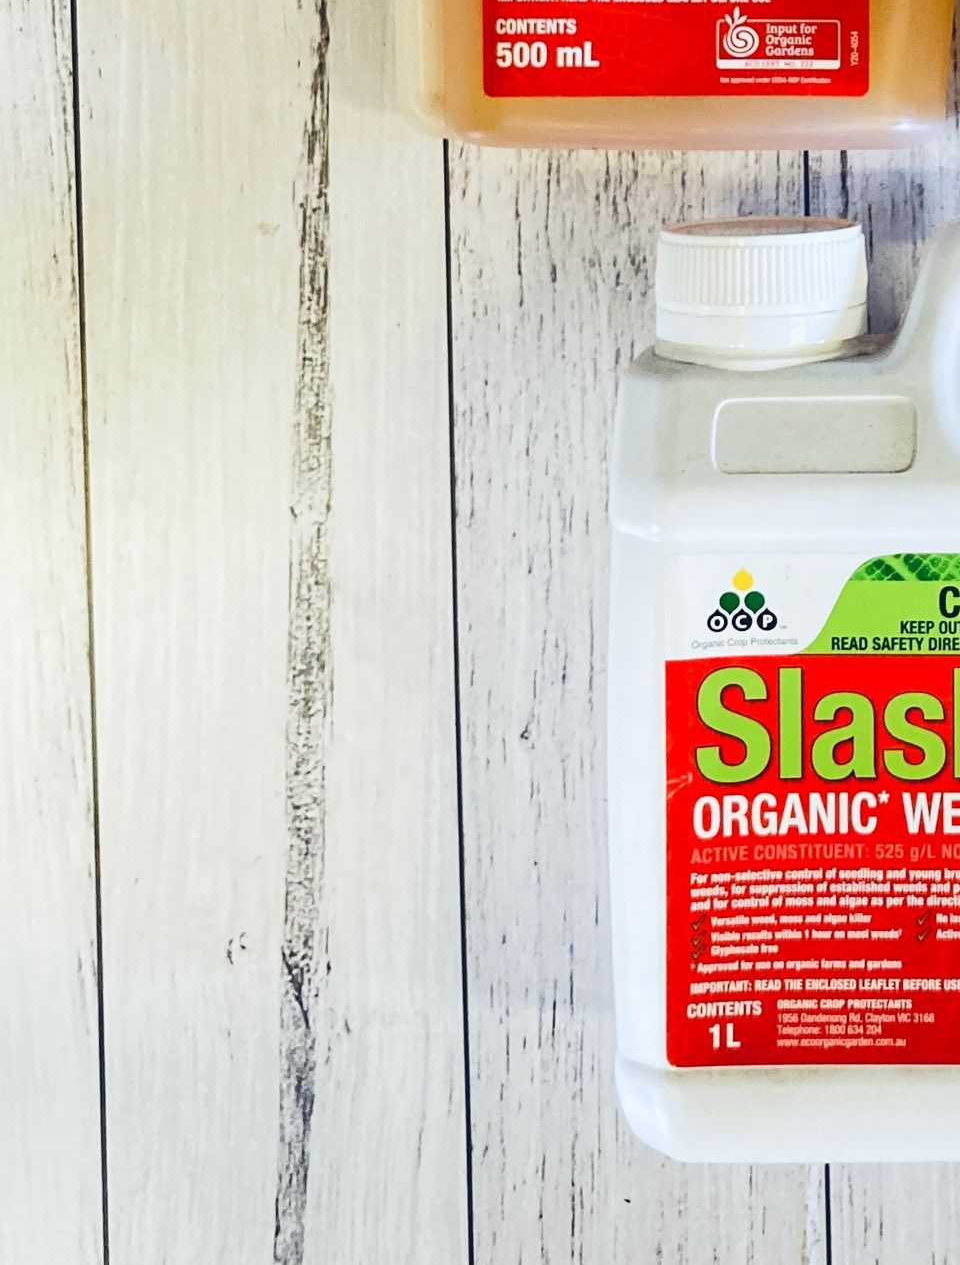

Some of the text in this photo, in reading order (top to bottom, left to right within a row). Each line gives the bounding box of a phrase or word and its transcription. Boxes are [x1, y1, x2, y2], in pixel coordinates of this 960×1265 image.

[496, 18, 576, 34] CONTENTS
[766, 22, 817, 37] Input for
[765, 34, 811, 48] Organic
[496, 41, 599, 67] 500 mL
[765, 45, 814, 56] Gardens
[900, 620, 934, 634] KEEP
[831, 636, 868, 651] READ
[872, 636, 923, 651] SAFETY
[690, 845, 748, 864] ACTIVE
[753, 844, 868, 860] CONSTITUENT:
[875, 843, 904, 859] 525
[909, 843, 935, 862] g/L
[687, 1000, 762, 1018] CONTENTS
